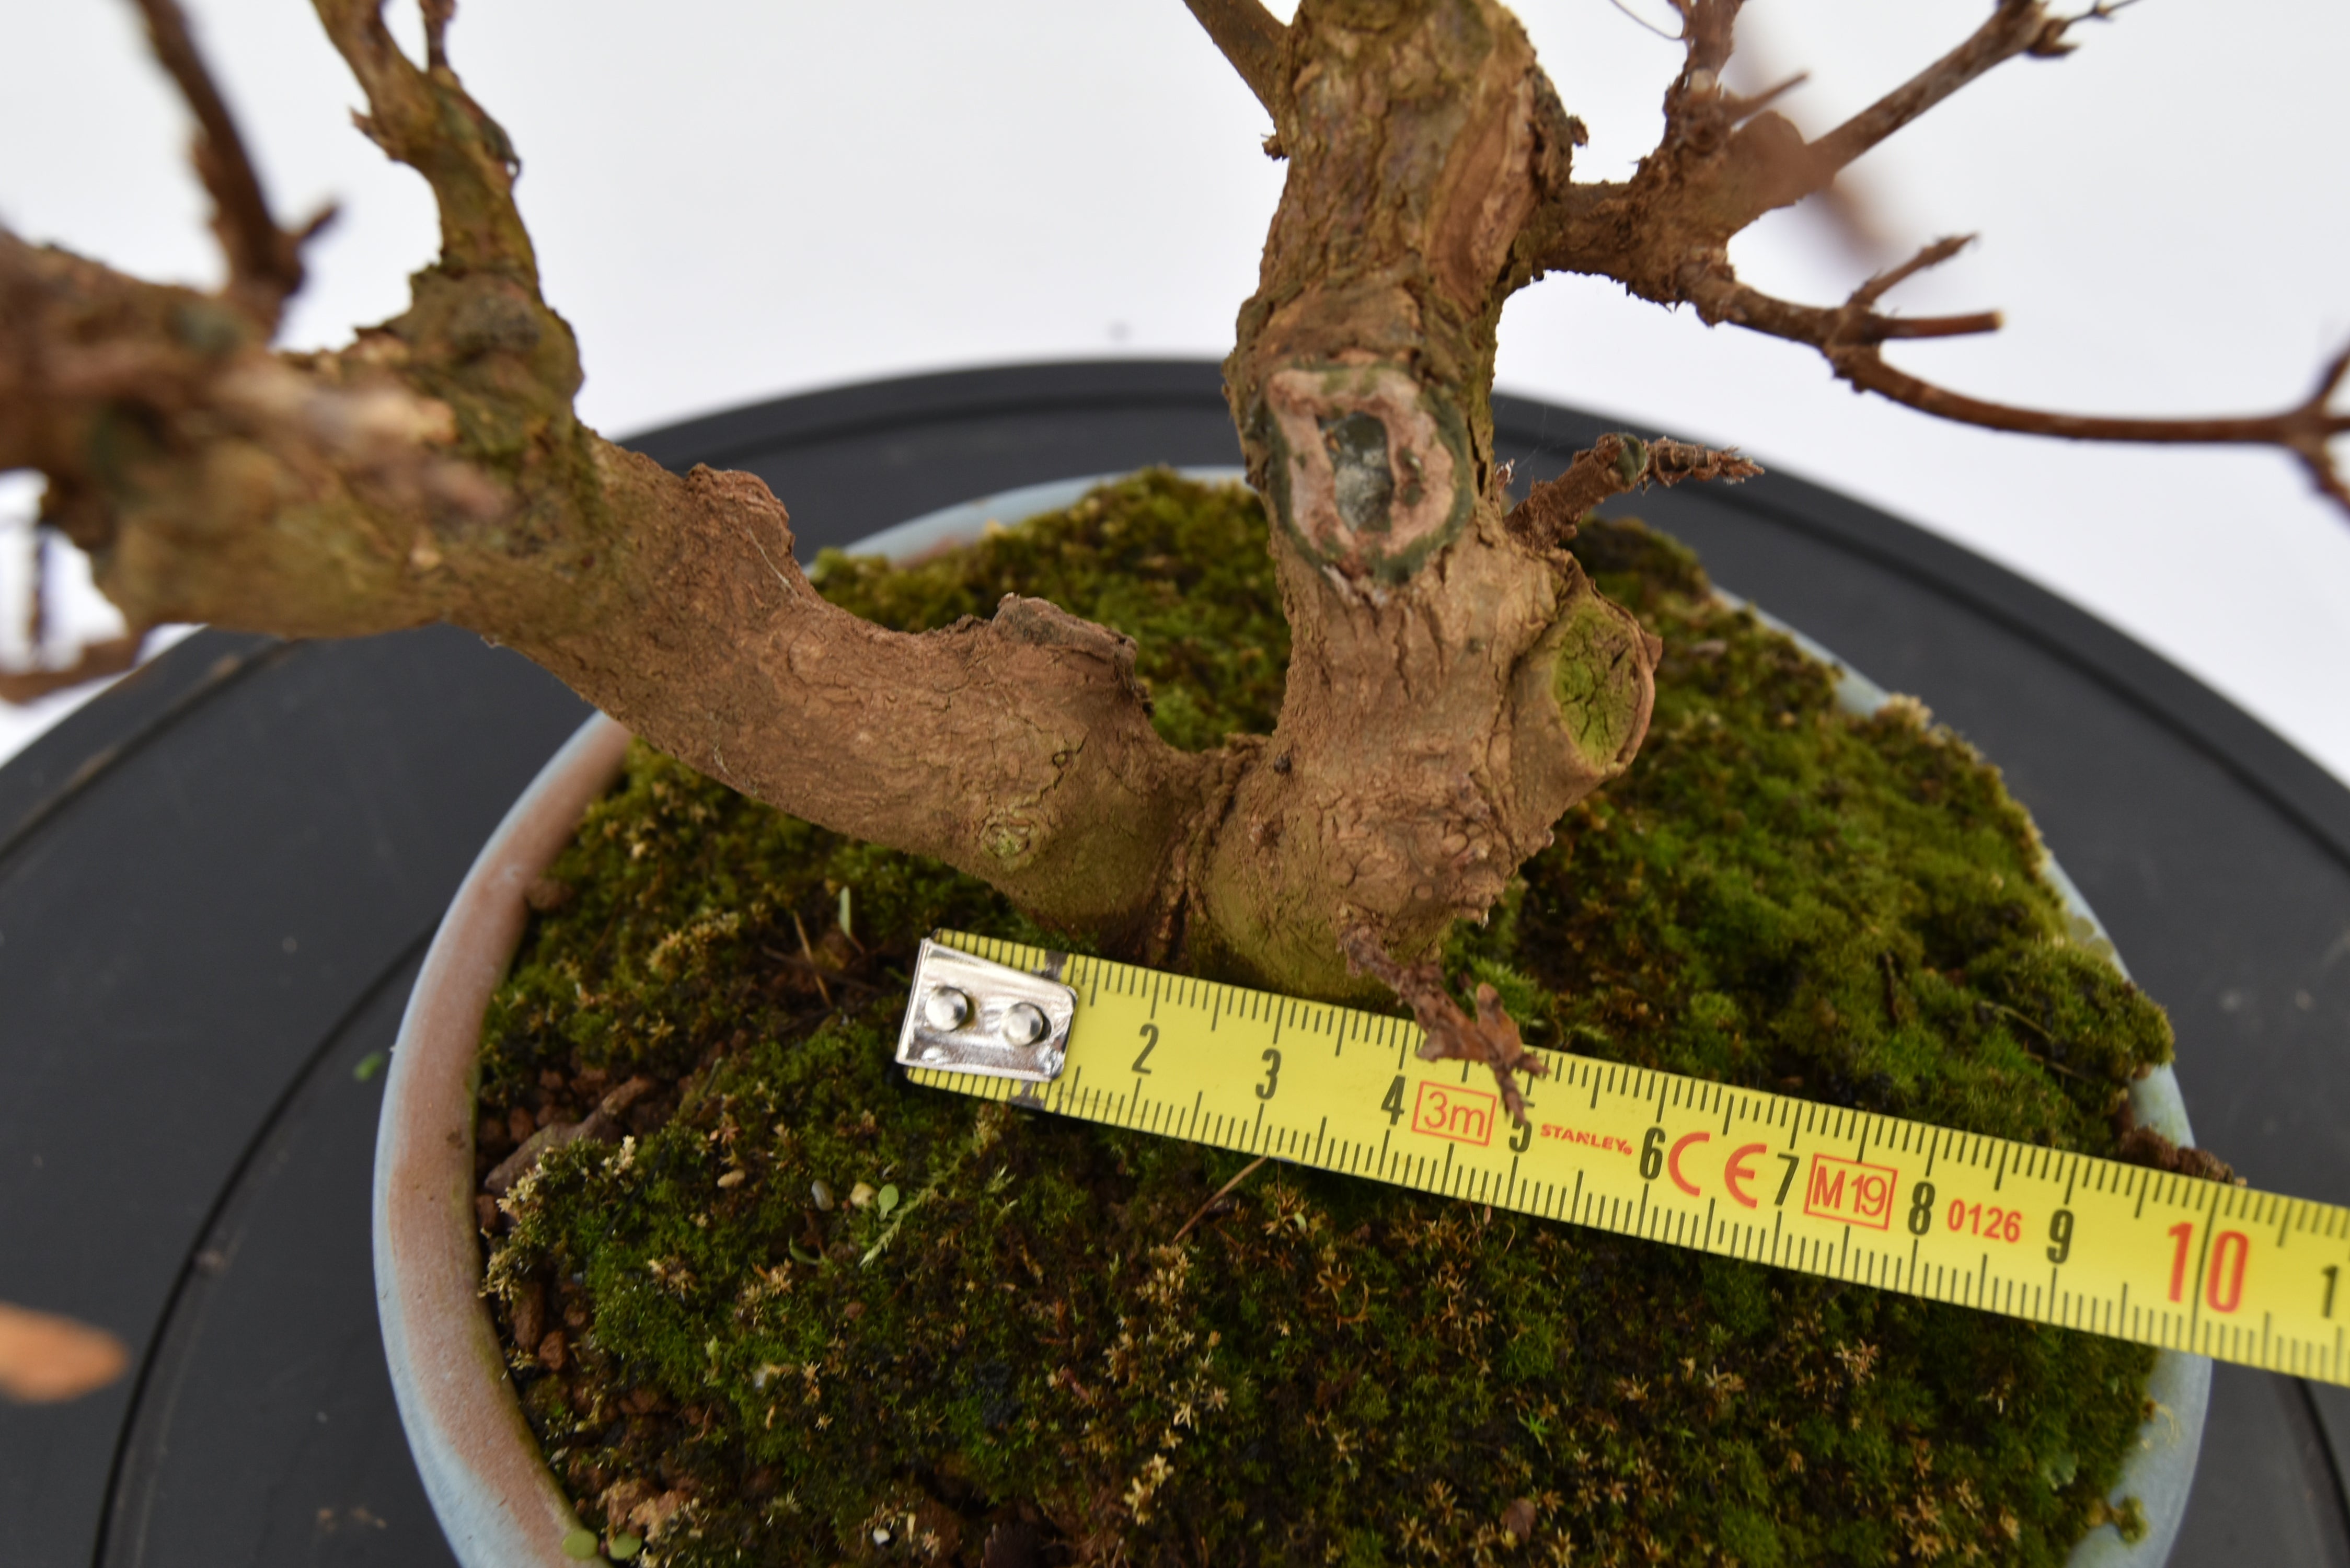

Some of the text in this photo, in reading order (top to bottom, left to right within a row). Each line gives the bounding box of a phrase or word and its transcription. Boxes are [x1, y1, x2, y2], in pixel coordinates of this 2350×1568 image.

[1132, 1023, 1159, 1075] 2
[1255, 1048, 1282, 1100] 3
[1381, 1075, 1406, 1125] 4
[1423, 1090, 1487, 1138] 3m
[1509, 1099, 1535, 1152] 5
[1540, 1123, 1628, 1154] STANLEY
[1639, 1127, 1666, 1181] 6
[1773, 1153, 1800, 1207] 7
[1908, 1181, 1936, 1236] 8
[1947, 1198, 2022, 1243] 0126
[2046, 1209, 2074, 1264] 9
[2167, 1221, 2250, 1313] 10
[2321, 1265, 2340, 1319] 1
